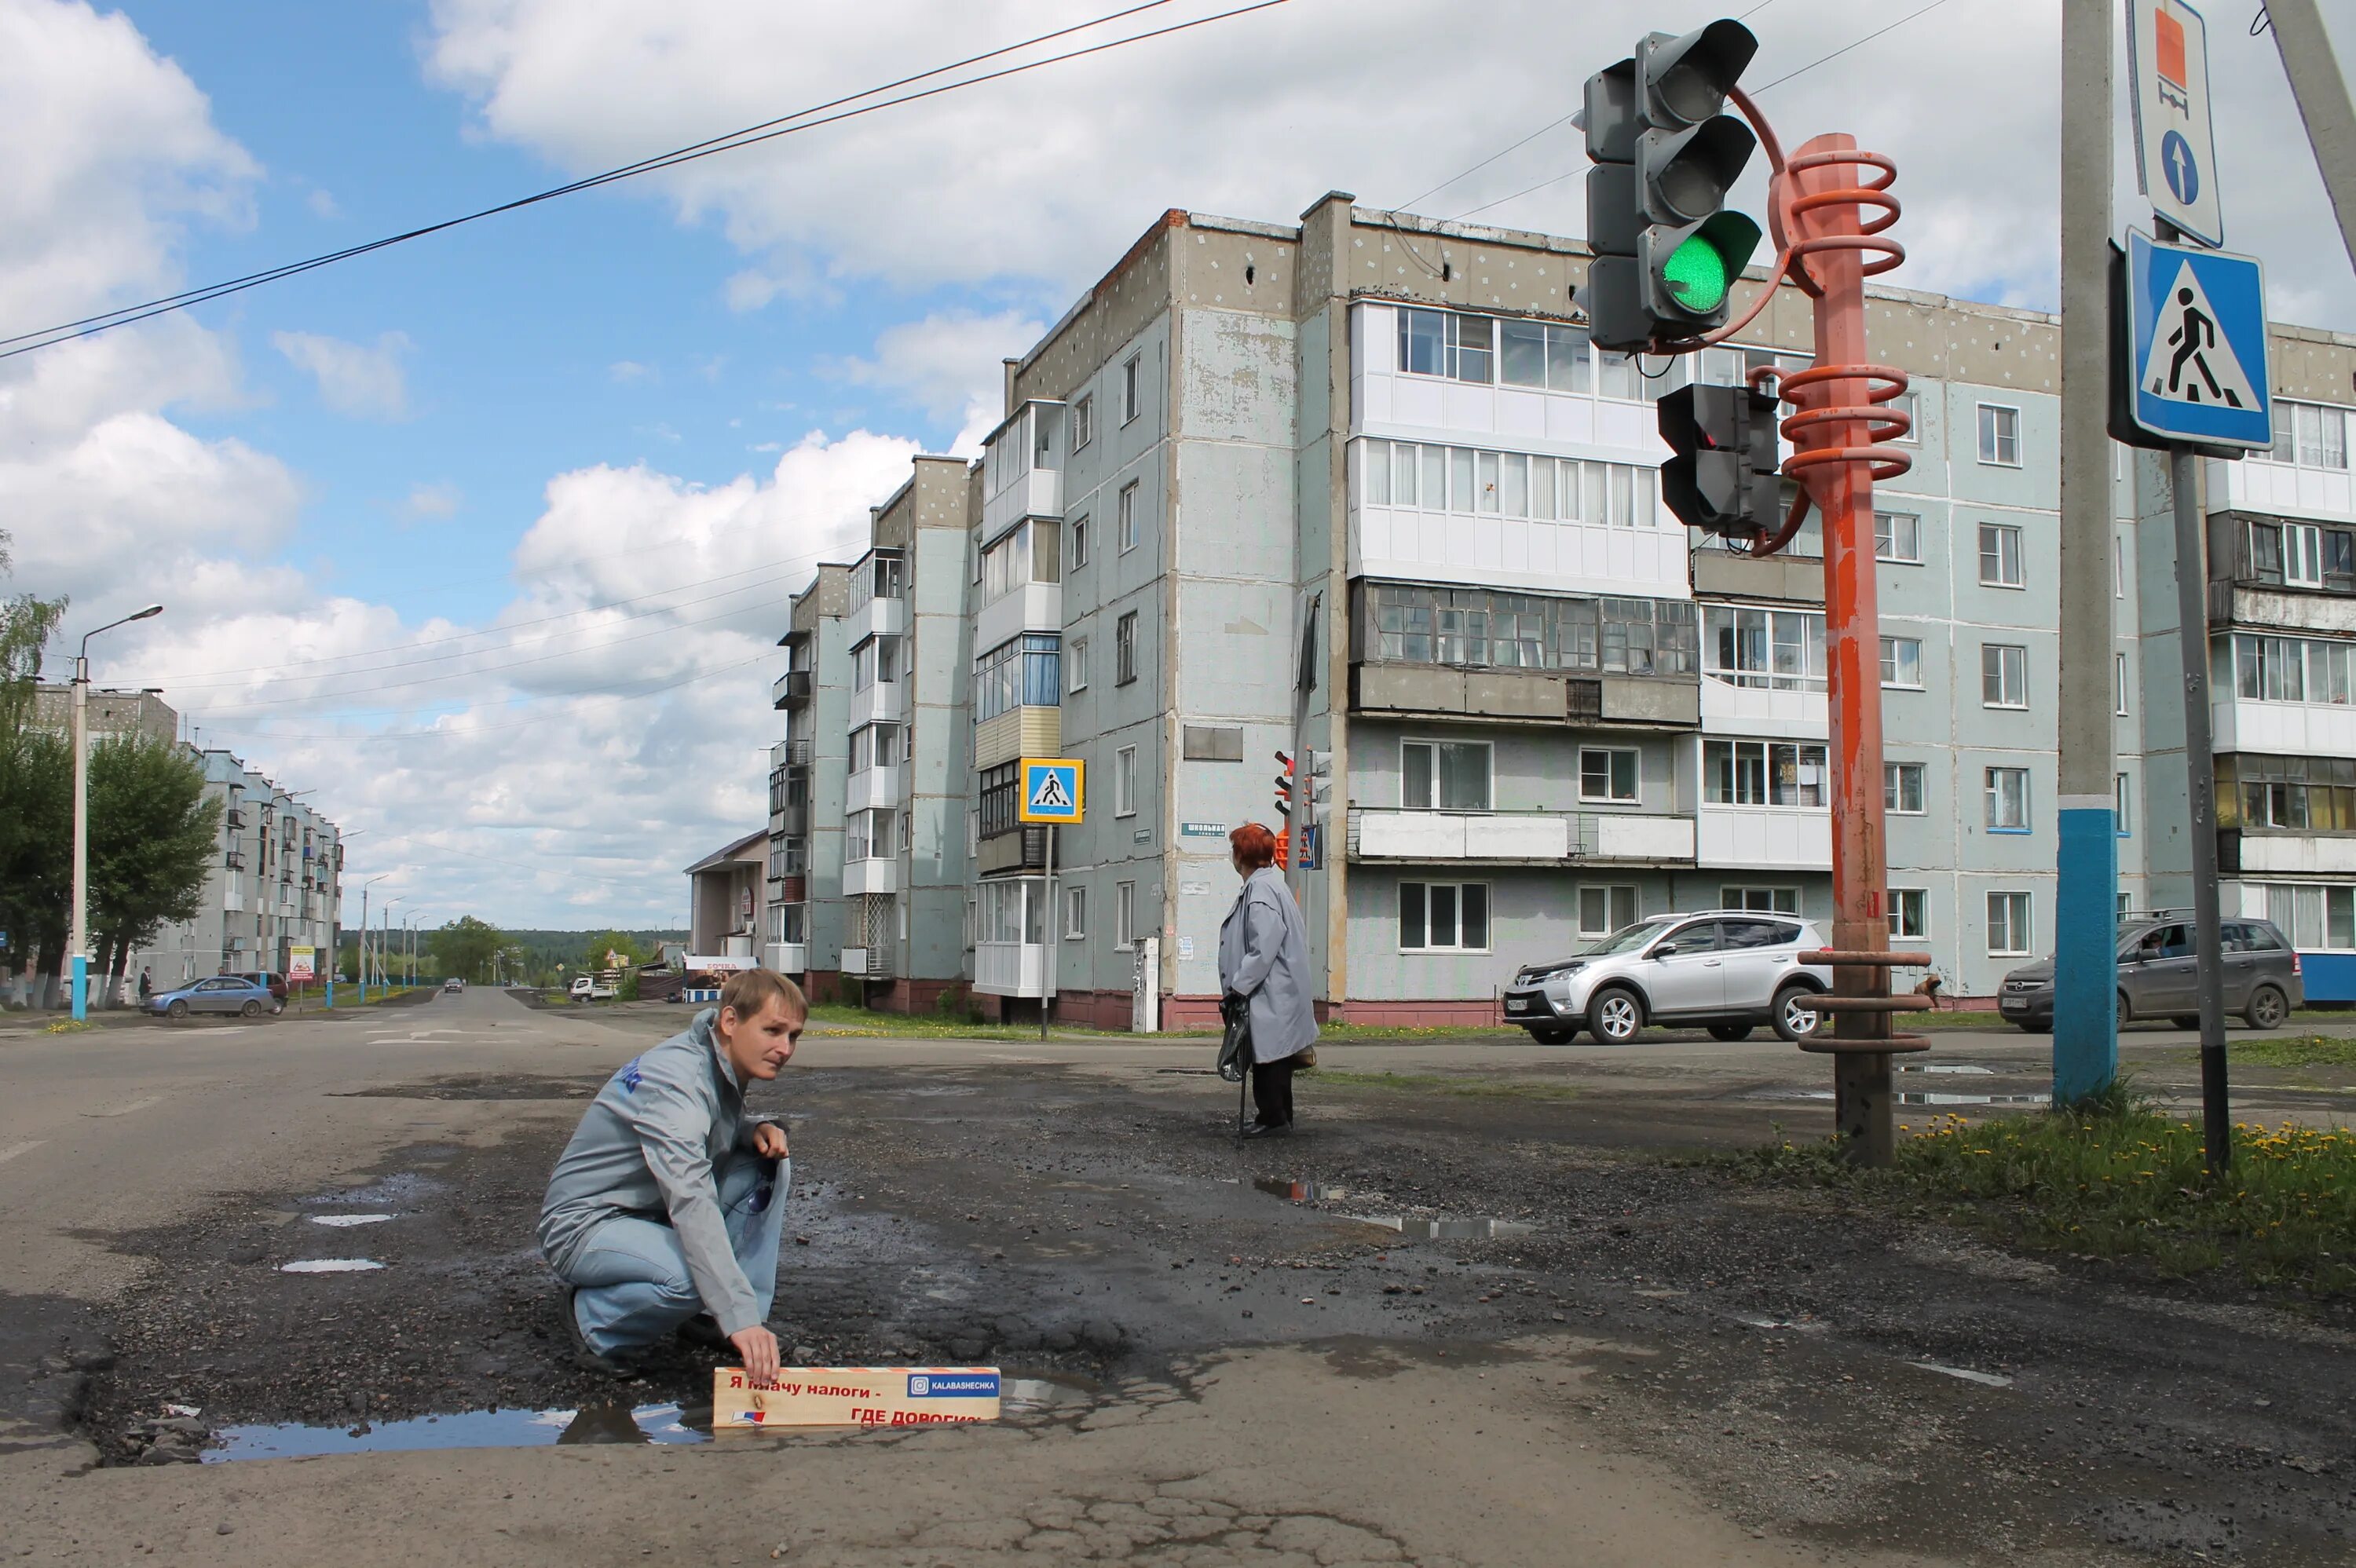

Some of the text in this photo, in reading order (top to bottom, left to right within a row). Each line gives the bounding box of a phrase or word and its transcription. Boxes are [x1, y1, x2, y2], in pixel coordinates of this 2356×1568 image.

[1188, 824, 1225, 832] ШКОЛЬНАЯ
[730, 1376, 742, 1388] Я
[807, 1384, 871, 1398] налоги
[931, 1381, 995, 1391] KALABASHECHKA
[851, 1408, 887, 1427] ГДЕ
